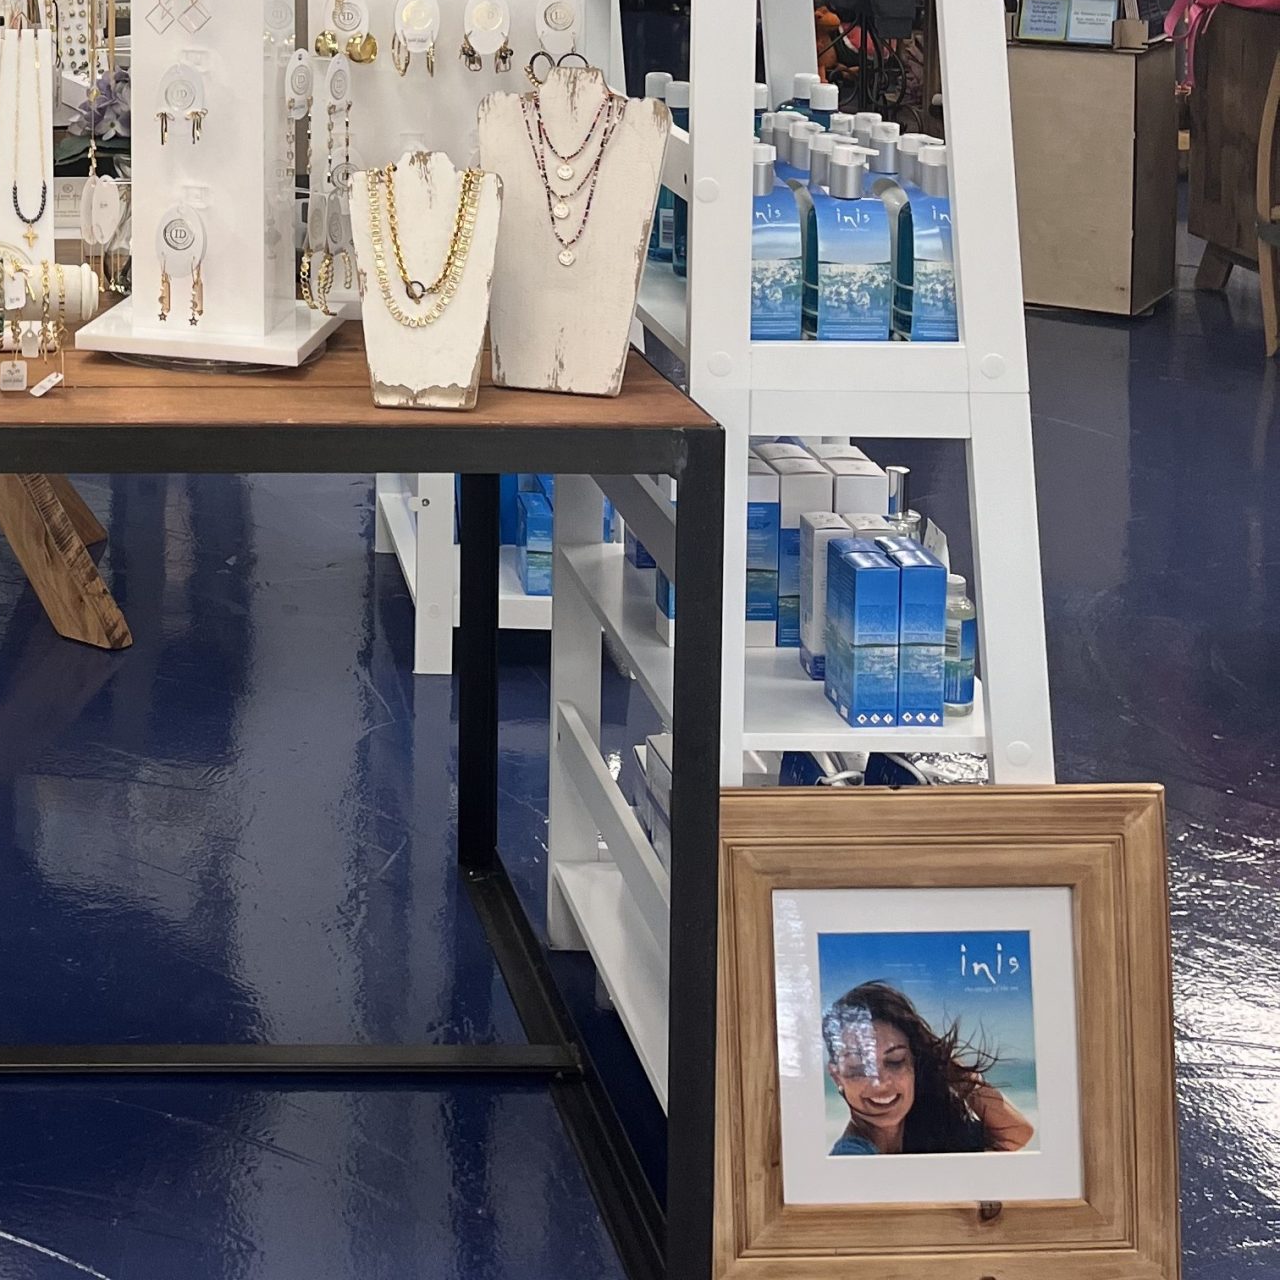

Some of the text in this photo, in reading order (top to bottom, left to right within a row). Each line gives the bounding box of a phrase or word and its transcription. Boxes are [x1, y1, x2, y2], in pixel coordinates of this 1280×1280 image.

[755, 203, 781, 223] nis
[836, 207, 870, 228] inis
[931, 205, 952, 224] in
[174, 228, 187, 239] ID
[960, 942, 1019, 985] inis
